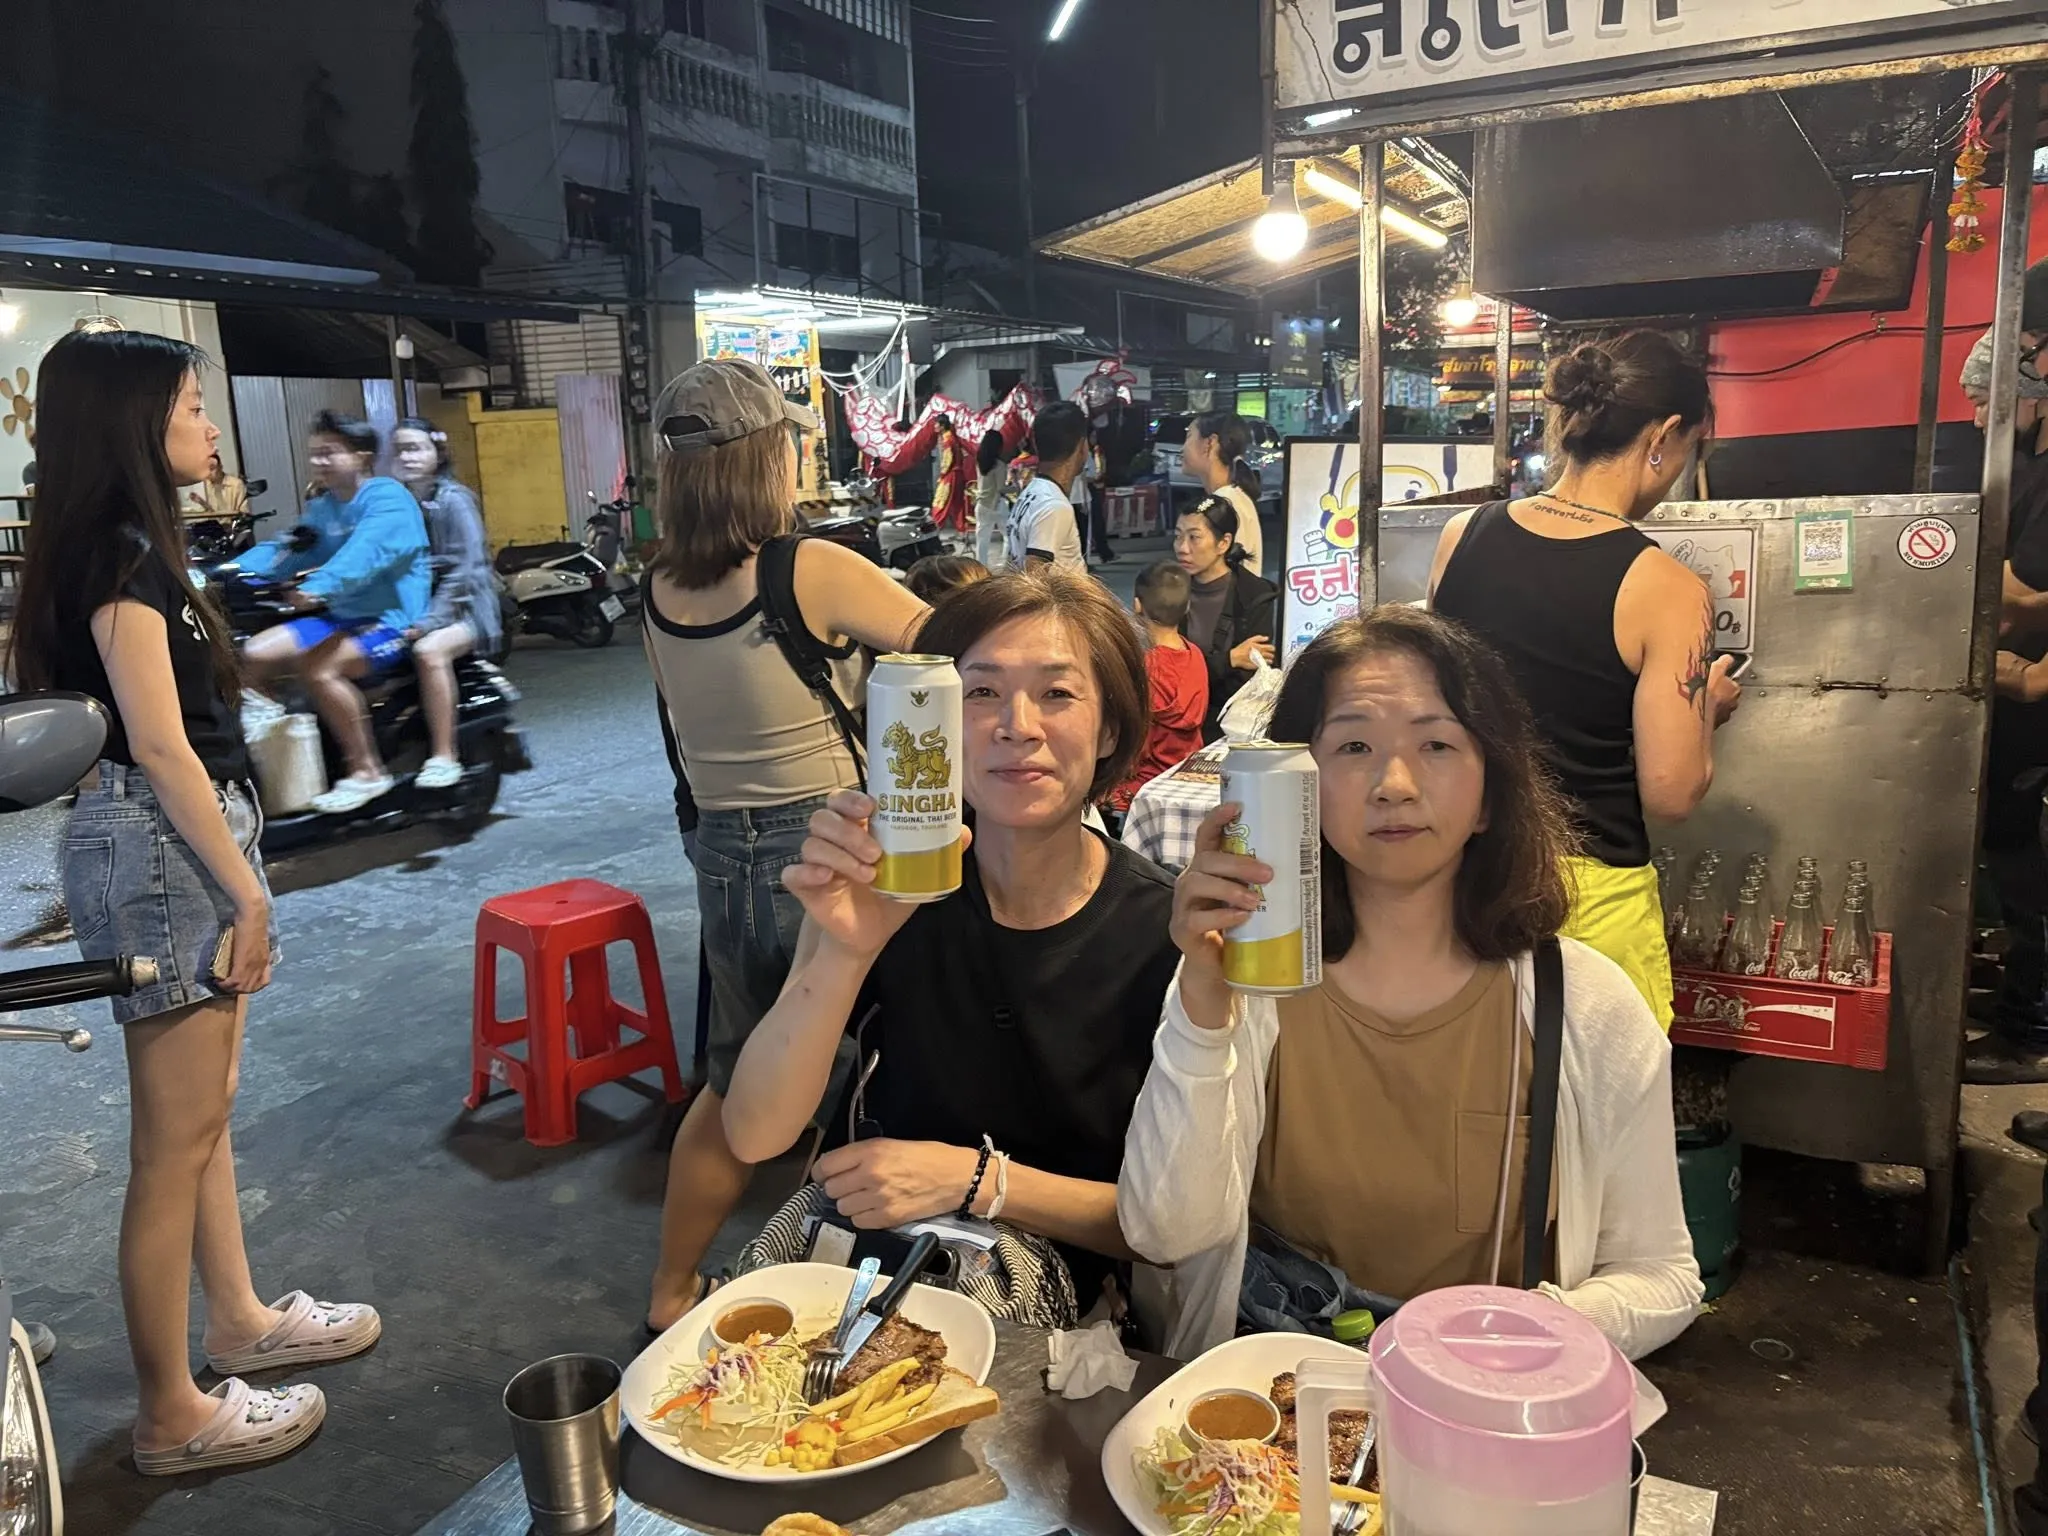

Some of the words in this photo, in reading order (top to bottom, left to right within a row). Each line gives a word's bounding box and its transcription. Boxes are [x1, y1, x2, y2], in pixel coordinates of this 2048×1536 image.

[879, 792, 956, 813] SINGHA
[891, 815, 925, 823] ORIGINAL
[927, 815, 942, 823] THAI
